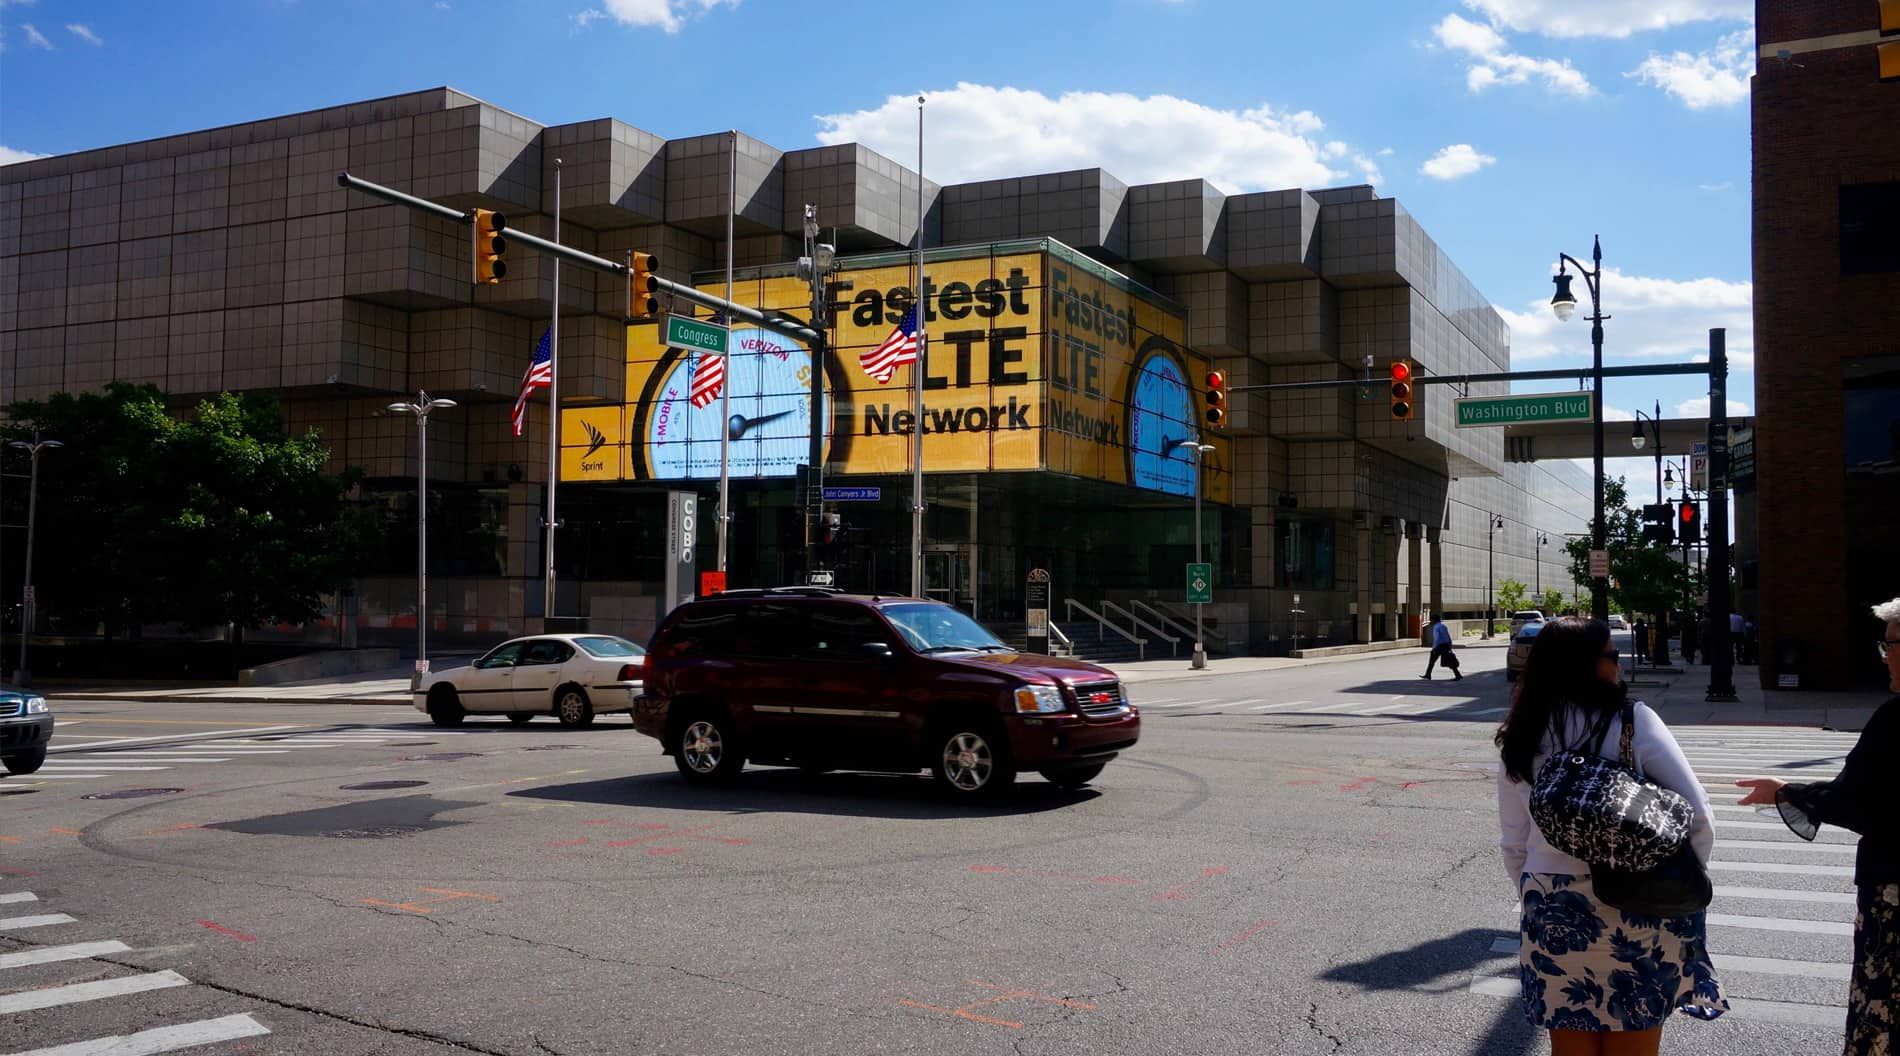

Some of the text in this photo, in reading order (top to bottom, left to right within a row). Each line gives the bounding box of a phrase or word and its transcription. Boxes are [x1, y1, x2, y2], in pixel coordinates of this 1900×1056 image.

[824, 268, 1030, 328] Fastest
[1052, 268, 1136, 349] Fastest
[678, 326, 718, 346] Congress
[741, 338, 790, 362] VERIZON
[920, 327, 1028, 390] LTE
[1052, 328, 1101, 400] LTE
[657, 387, 678, 448] T-MOBILE
[864, 396, 1031, 436] Network
[1050, 398, 1120, 448] Network
[1462, 400, 1587, 420] Washington Blvd
[581, 461, 603, 473] Sprint
[682, 499, 694, 563] COBO
